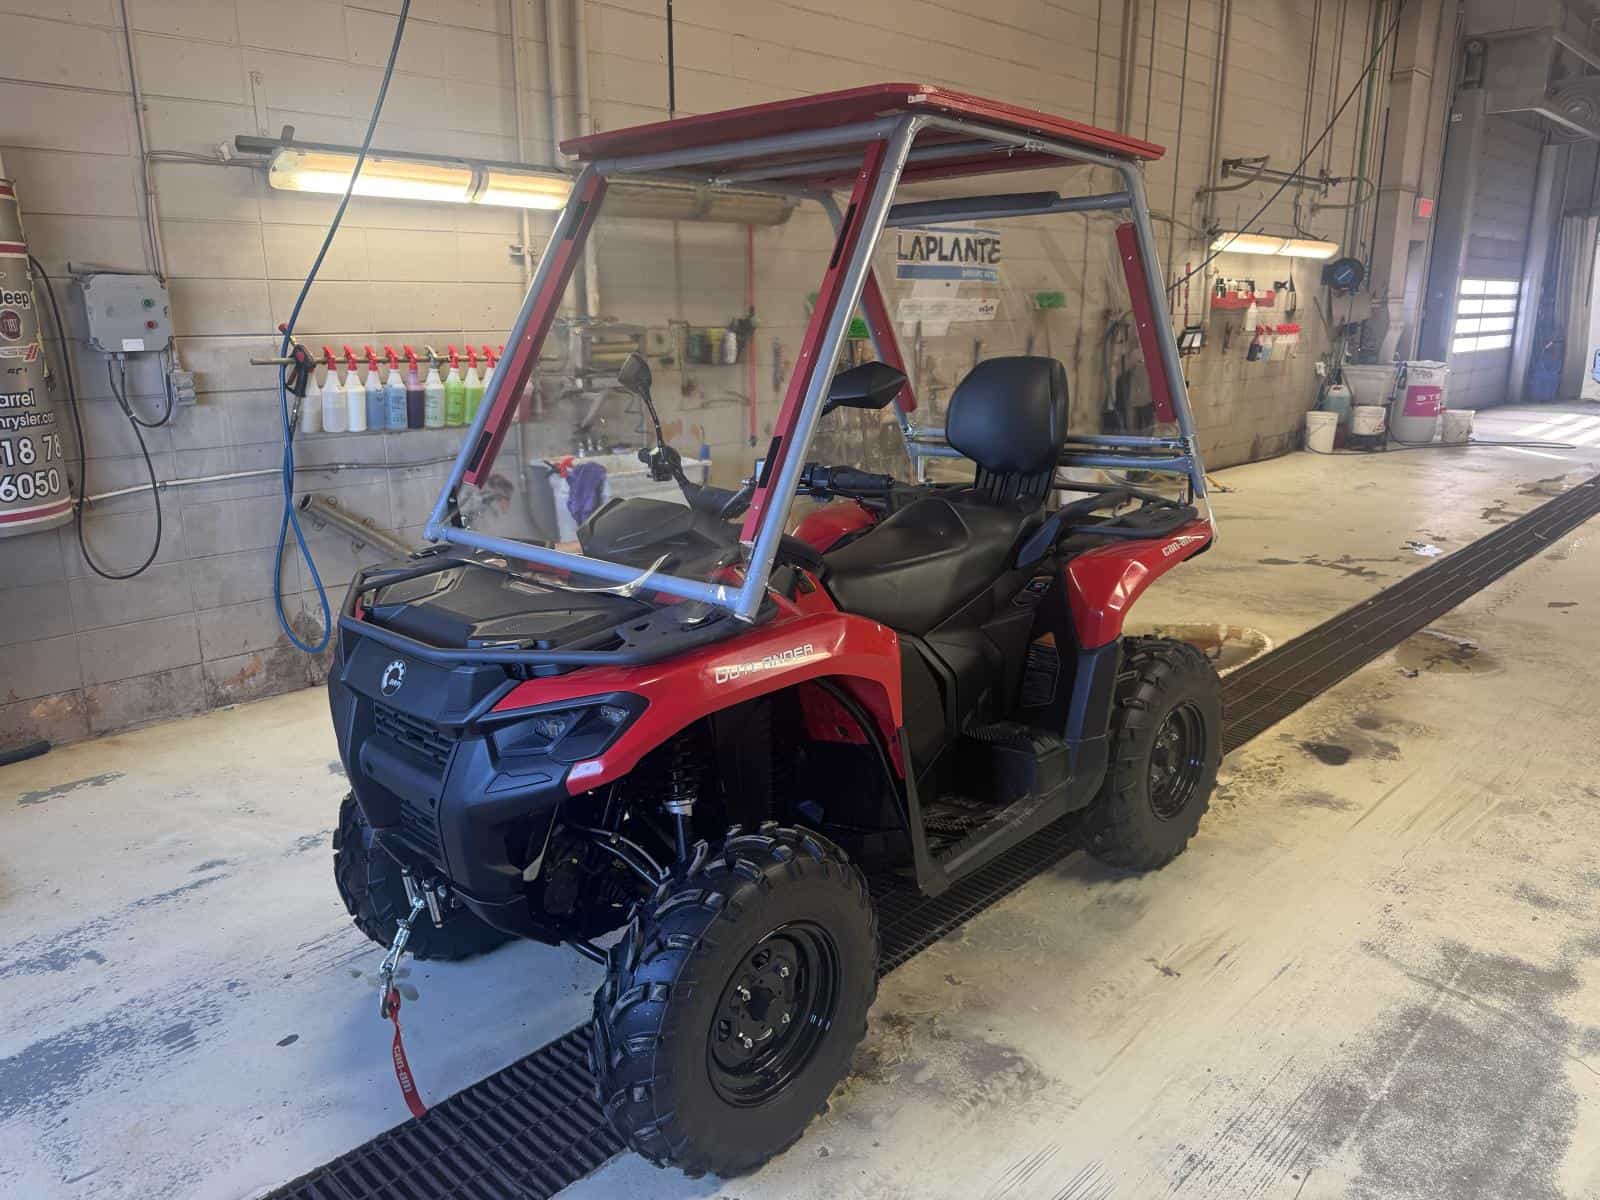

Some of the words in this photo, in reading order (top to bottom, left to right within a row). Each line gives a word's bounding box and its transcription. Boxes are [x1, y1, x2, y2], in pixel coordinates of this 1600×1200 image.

[896, 234, 1001, 264] LAPLANTE
[1, 437, 36, 467] 18
[0, 468, 60, 502] 6050
